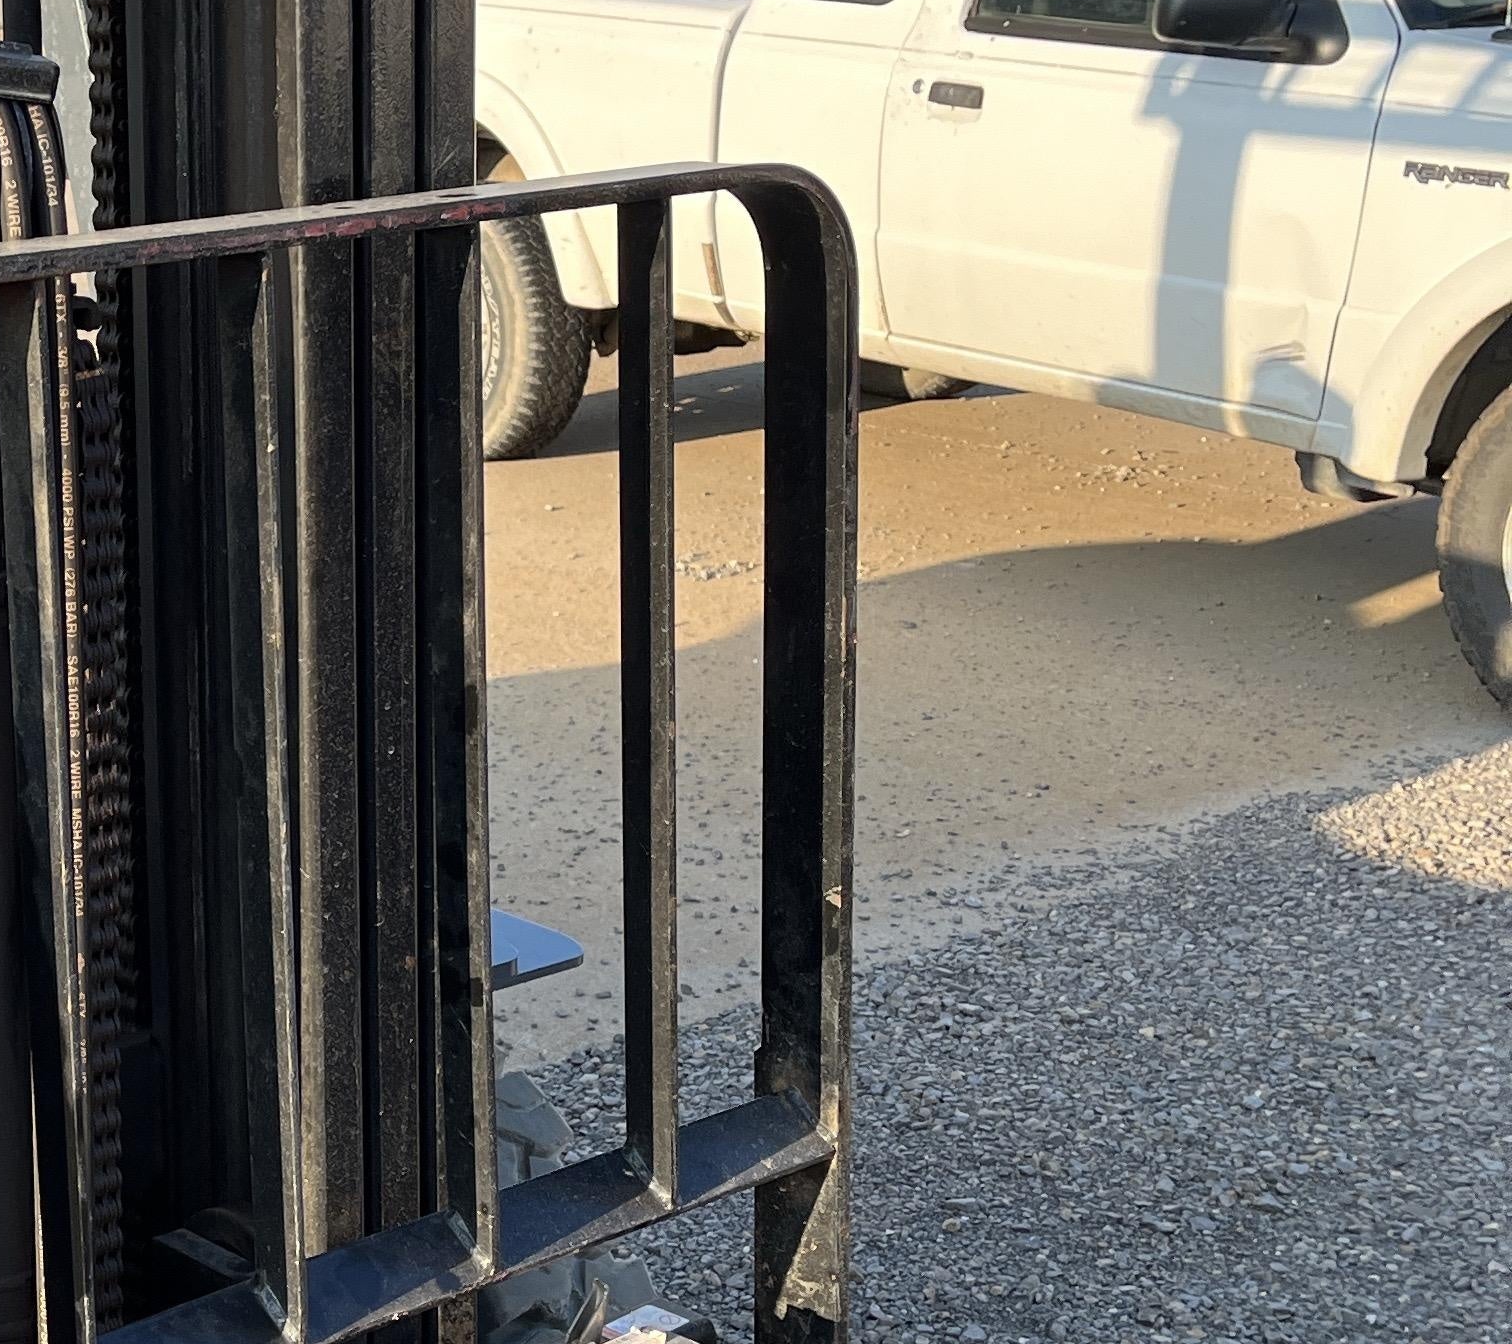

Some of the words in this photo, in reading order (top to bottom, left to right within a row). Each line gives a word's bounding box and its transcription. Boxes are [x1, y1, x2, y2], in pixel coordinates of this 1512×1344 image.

[4, 178, 17, 191] 2
[36, 133, 59, 208] IC-101/34
[6, 193, 22, 239] WIRE
[55, 293, 67, 323] 6TX
[57, 345, 69, 375] 3/8"
[58, 383, 70, 410] (9.5
[60, 414, 72, 446] mm)
[61, 468, 74, 503] 4000
[63, 506, 75, 531] PSI
[64, 535, 76, 560] WP
[64, 567, 76, 597] (276
[66, 601, 78, 637] BAR)
[67, 655, 81, 738] SAE100R16
[70, 749, 81, 759] 2
[70, 762, 83, 800] WIRE
[71, 808, 83, 849] MSHA
